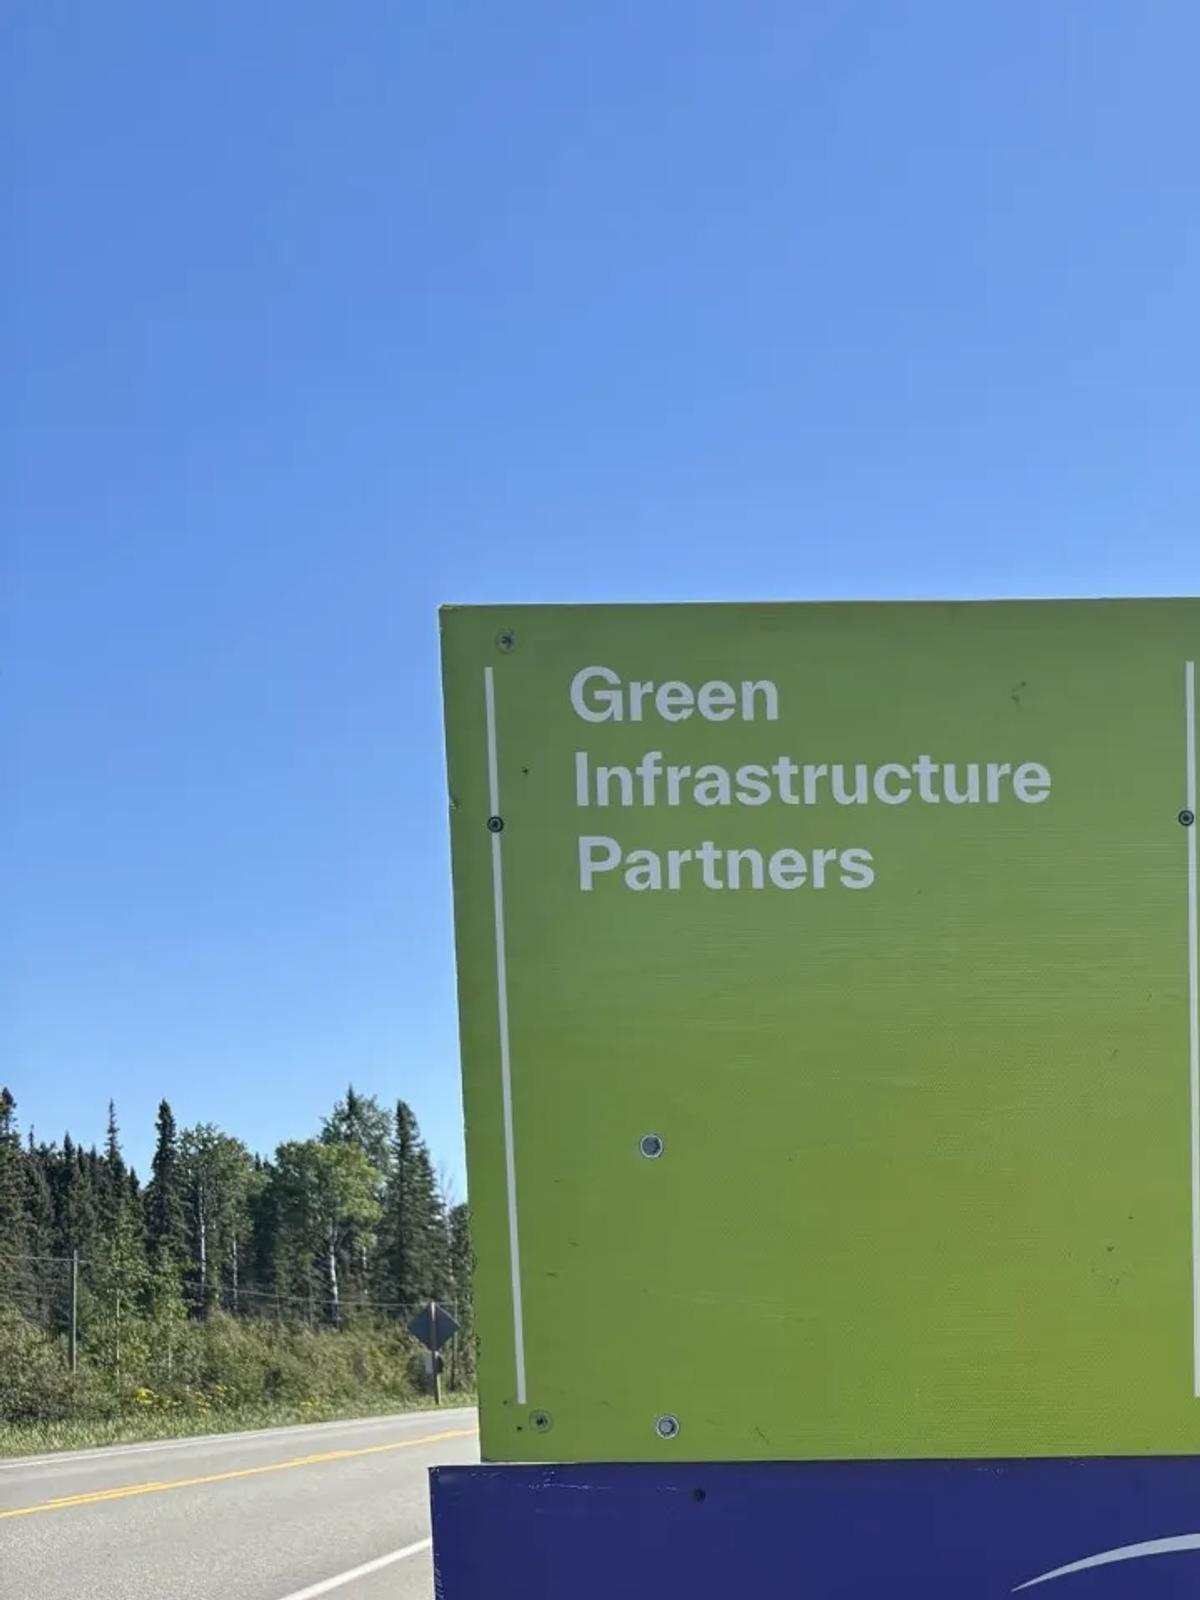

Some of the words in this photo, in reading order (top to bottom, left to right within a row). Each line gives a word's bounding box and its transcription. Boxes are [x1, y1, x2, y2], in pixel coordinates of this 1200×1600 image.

[571, 666, 778, 722] Green
[576, 752, 1051, 806] Infrastructure
[579, 836, 874, 890] Partners
